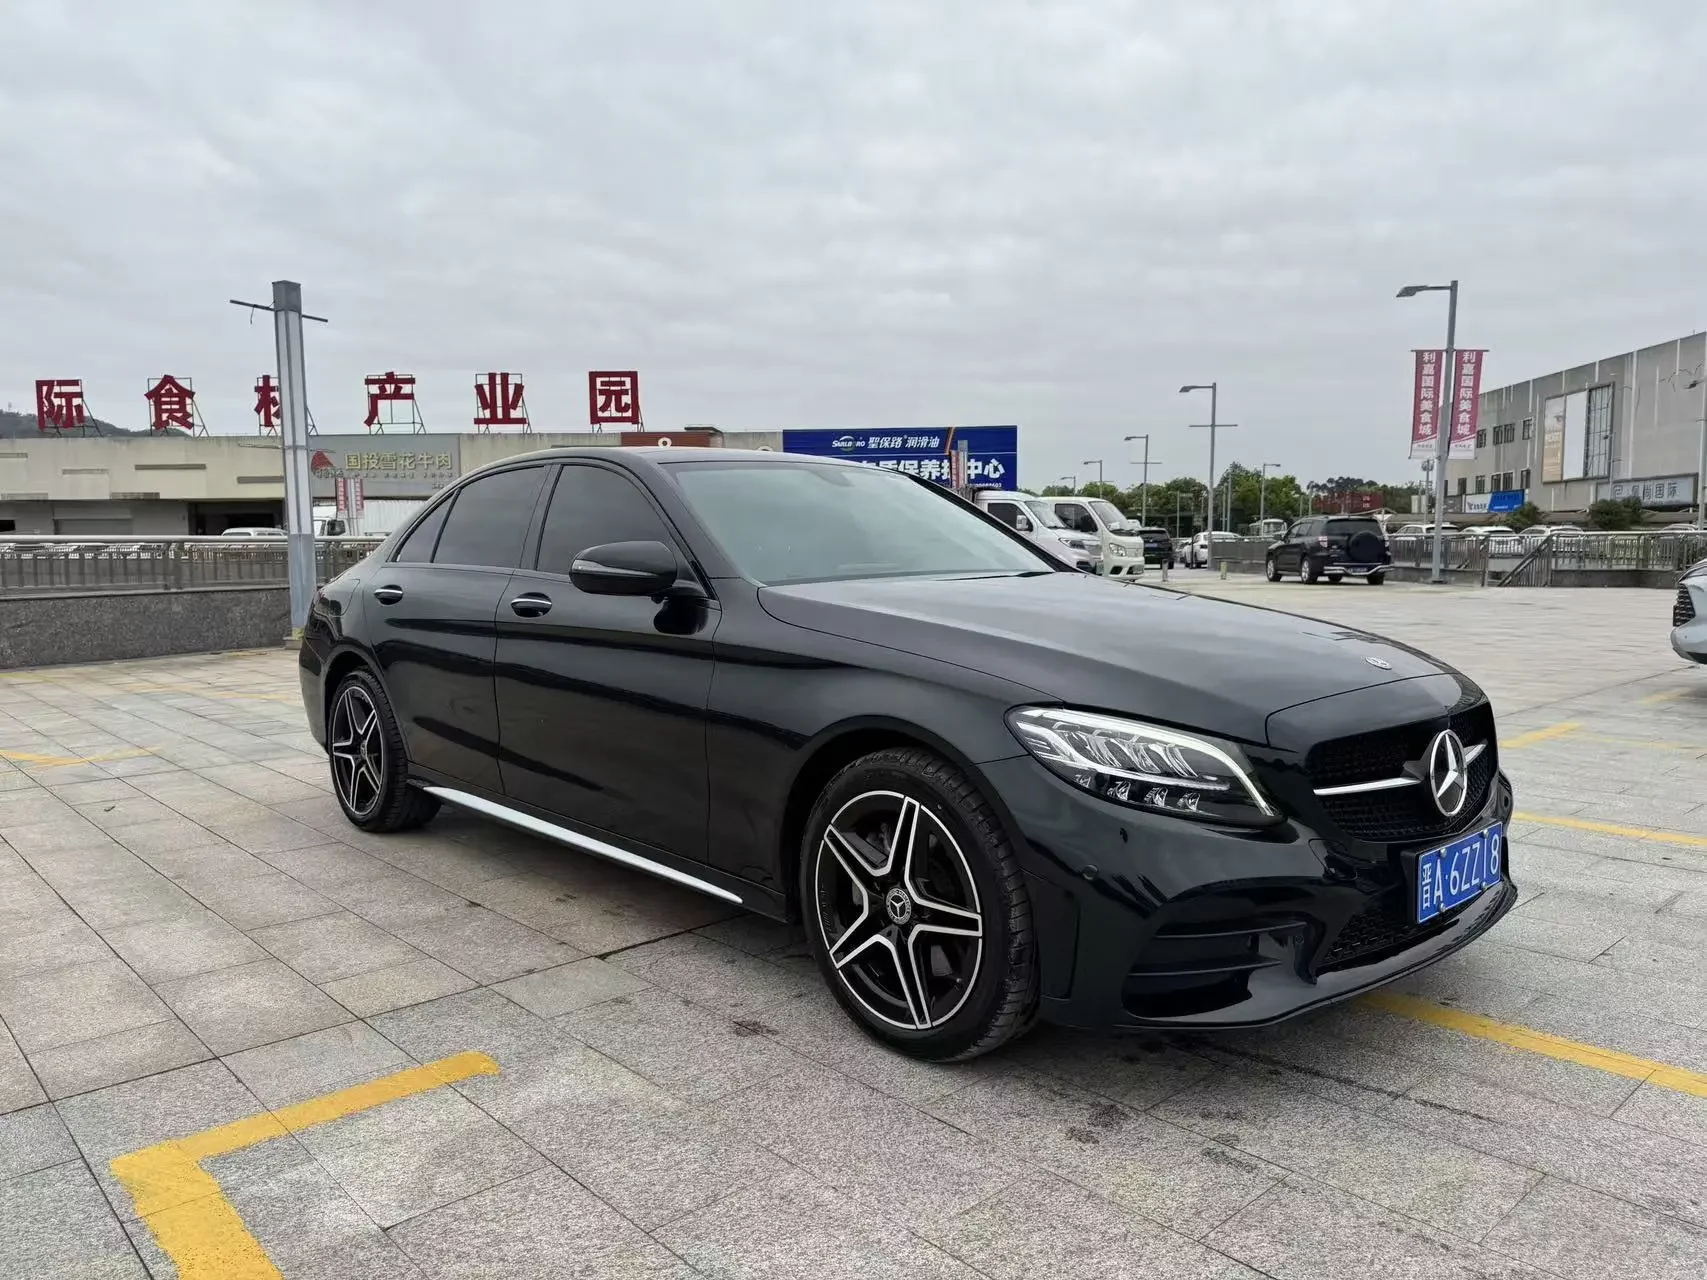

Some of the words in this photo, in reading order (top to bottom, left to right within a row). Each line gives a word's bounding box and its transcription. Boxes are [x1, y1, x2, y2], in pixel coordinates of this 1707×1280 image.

[345, 452, 453, 470] 国投雪花牛肉
